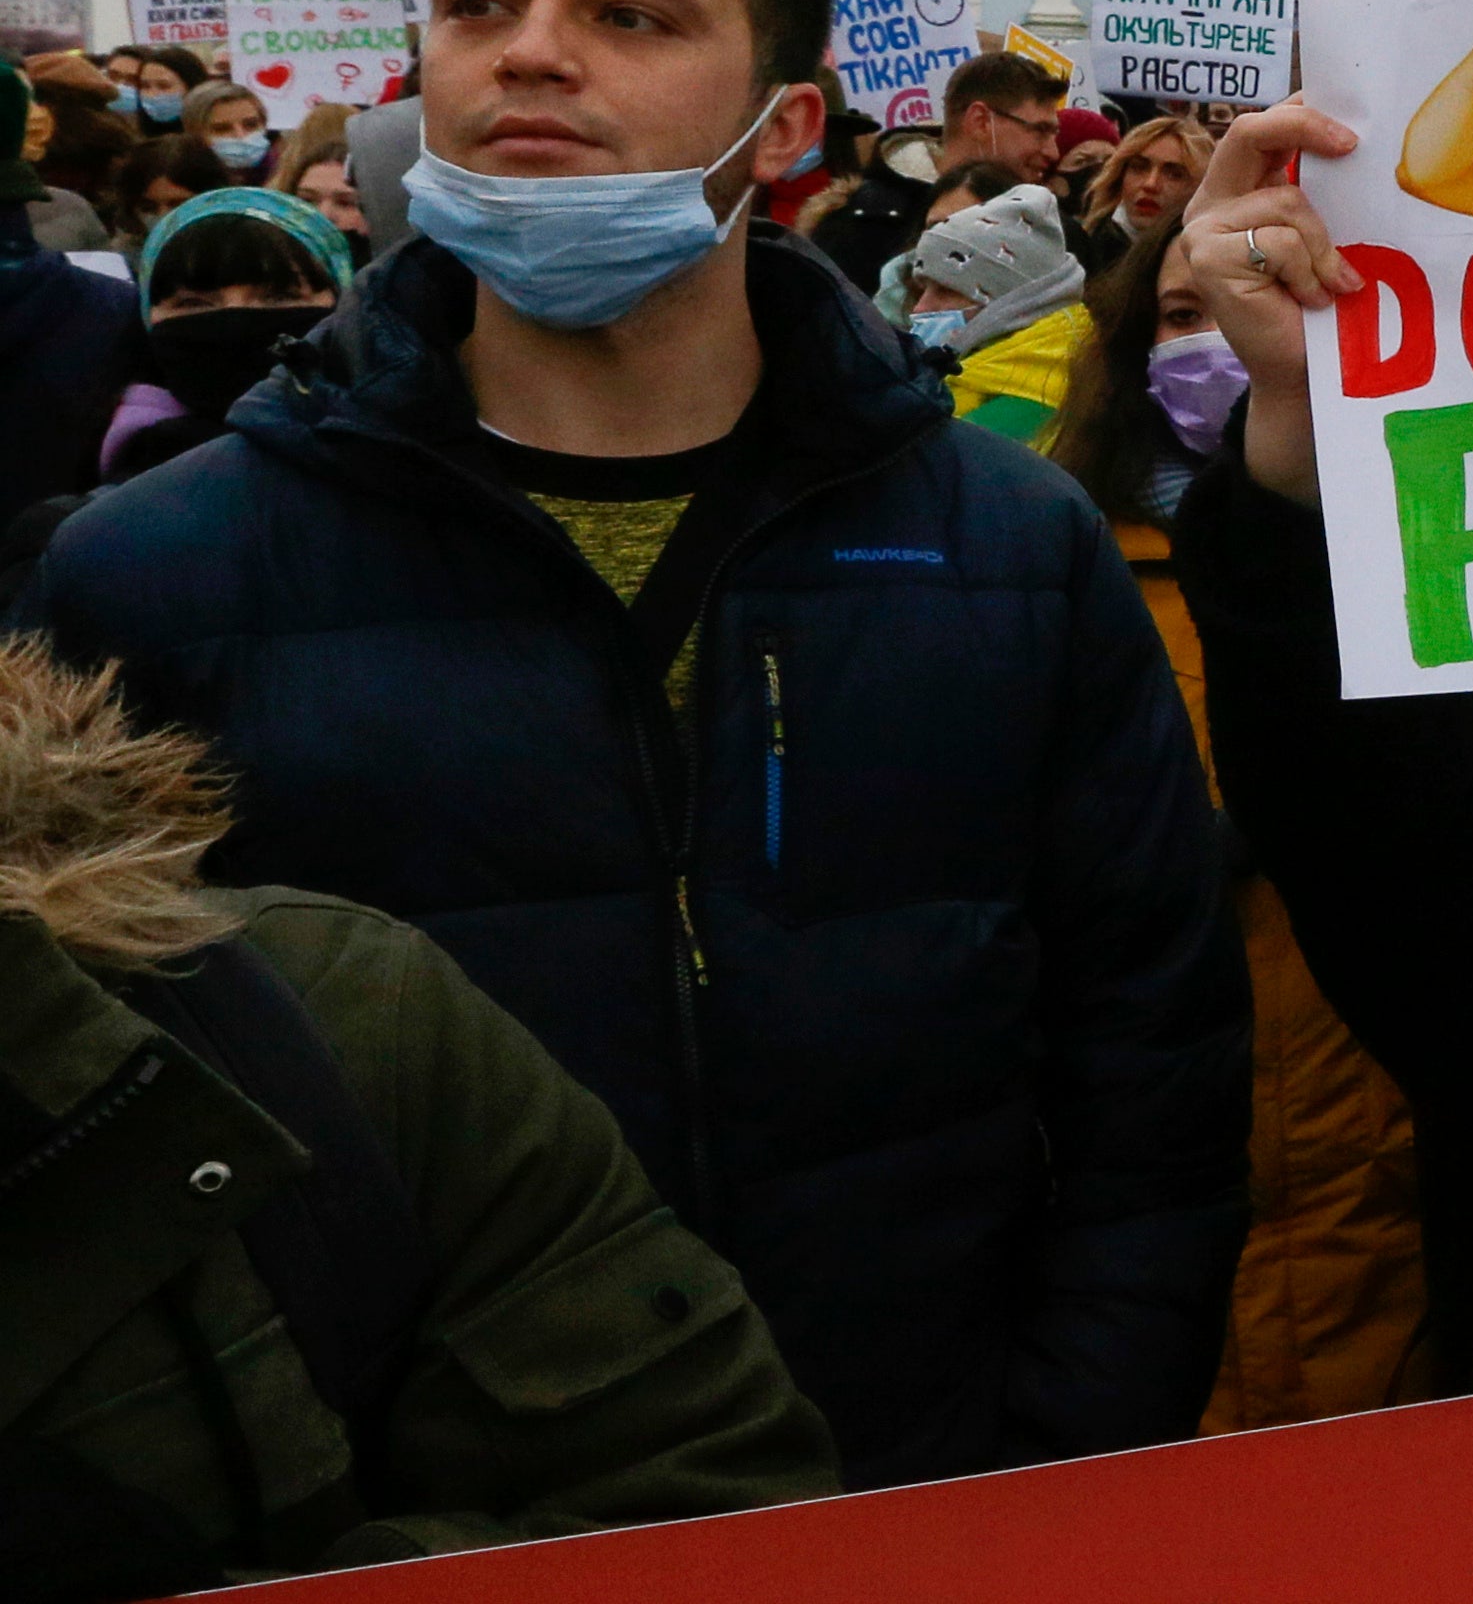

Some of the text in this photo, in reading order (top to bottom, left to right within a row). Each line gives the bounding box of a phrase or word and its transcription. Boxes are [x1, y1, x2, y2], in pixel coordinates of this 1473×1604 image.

[848, 15, 920, 55] СОБІ
[1104, 14, 1276, 55] ОКУЛЬТУРЕНЕ
[1121, 56, 1260, 97] РАБСТВО
